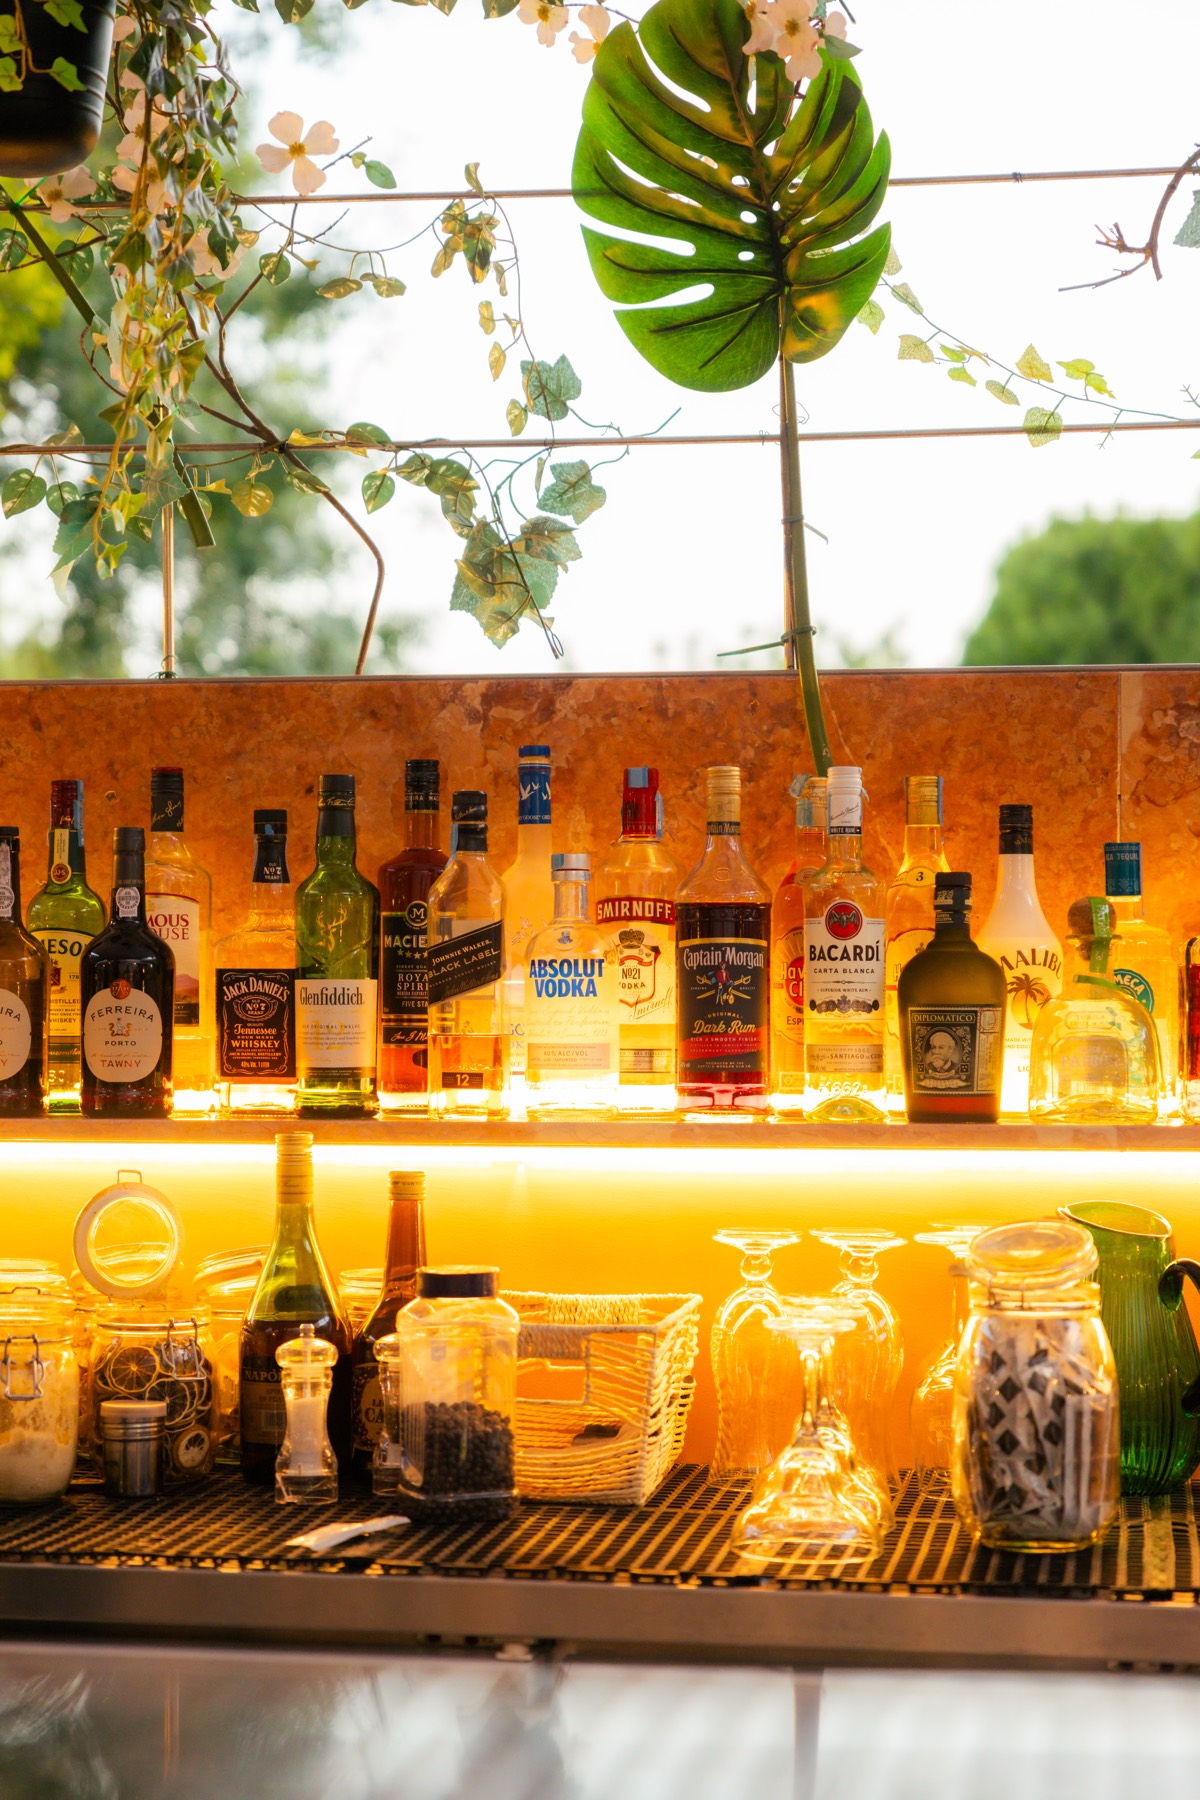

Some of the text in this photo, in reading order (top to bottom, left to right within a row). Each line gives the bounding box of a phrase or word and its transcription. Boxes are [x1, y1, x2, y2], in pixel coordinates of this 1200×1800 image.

[1116, 853, 1139, 861] TEQUIL
[916, 871, 924, 882] 3
[597, 900, 672, 920] SMIRNOFF
[147, 913, 190, 928] MOUS
[432, 950, 462, 966] JOHNNIE
[683, 946, 764, 970] Captain Morgan
[809, 940, 880, 962] BACARDÍ
[428, 948, 500, 979] BLACK LABEL
[529, 958, 605, 979] ABSOLUT
[398, 973, 429, 982] ROYA
[1114, 974, 1146, 995] MECA
[222, 976, 291, 1002] JACK DANIEL'S
[397, 982, 429, 991] SPIRI
[535, 978, 598, 998] VODKA
[619, 982, 646, 990] ODKA
[300, 986, 363, 1006] Glenfiddich
[90, 1005, 154, 1023] FERREIRA
[913, 1012, 975, 1022] DIPLOMÁTICO
[234, 1023, 278, 1035] Tennessee
[692, 1019, 757, 1035] Dark Rum
[231, 1040, 280, 1048] WHISKEY
[100, 1059, 142, 1068] TAWNY
[455, 1074, 470, 1087] 12
